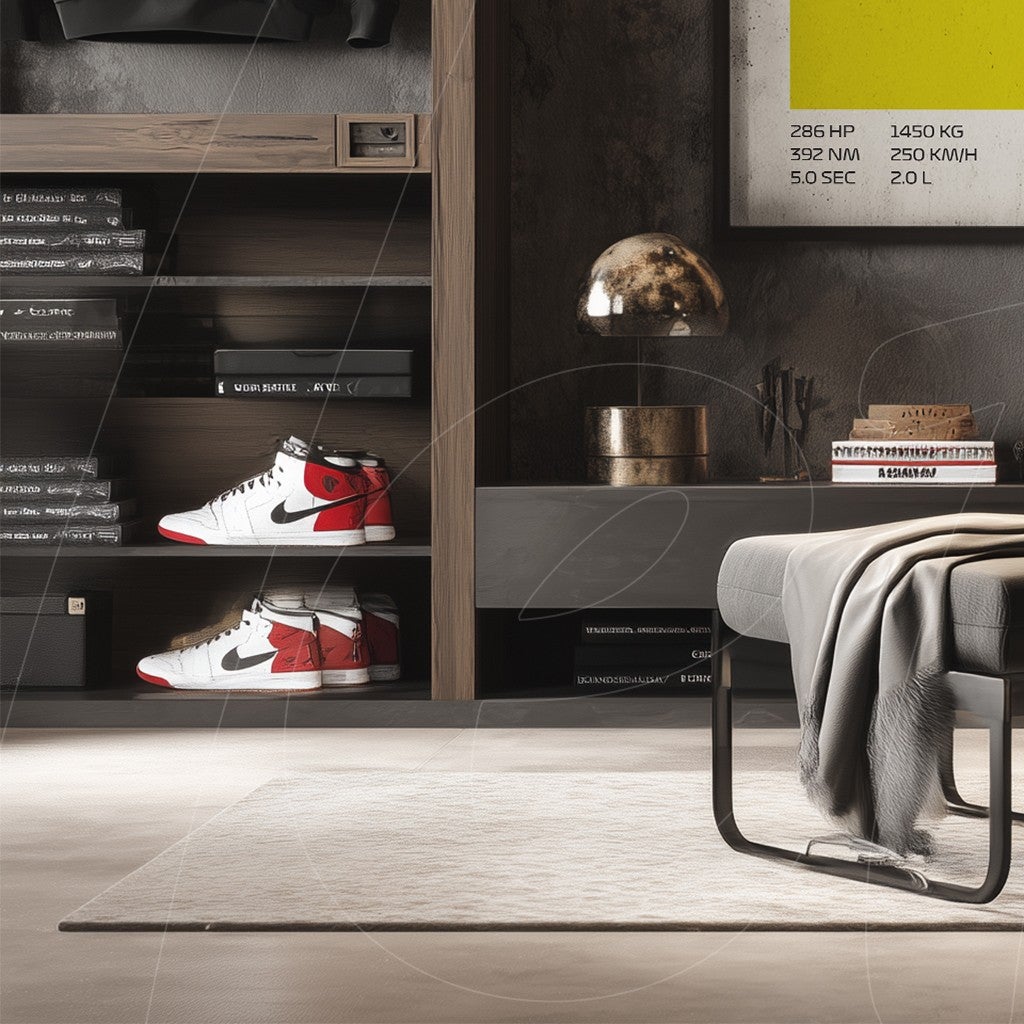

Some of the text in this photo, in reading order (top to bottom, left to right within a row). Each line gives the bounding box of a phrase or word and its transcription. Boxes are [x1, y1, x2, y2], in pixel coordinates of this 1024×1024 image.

[790, 124, 855, 138] 286 HP
[890, 124, 964, 139] 1450 KG
[790, 147, 861, 162] 392 NM
[890, 147, 978, 163] 250 KM/H
[790, 170, 856, 185] 5.0 SEC
[890, 170, 932, 185] 2.0 L
